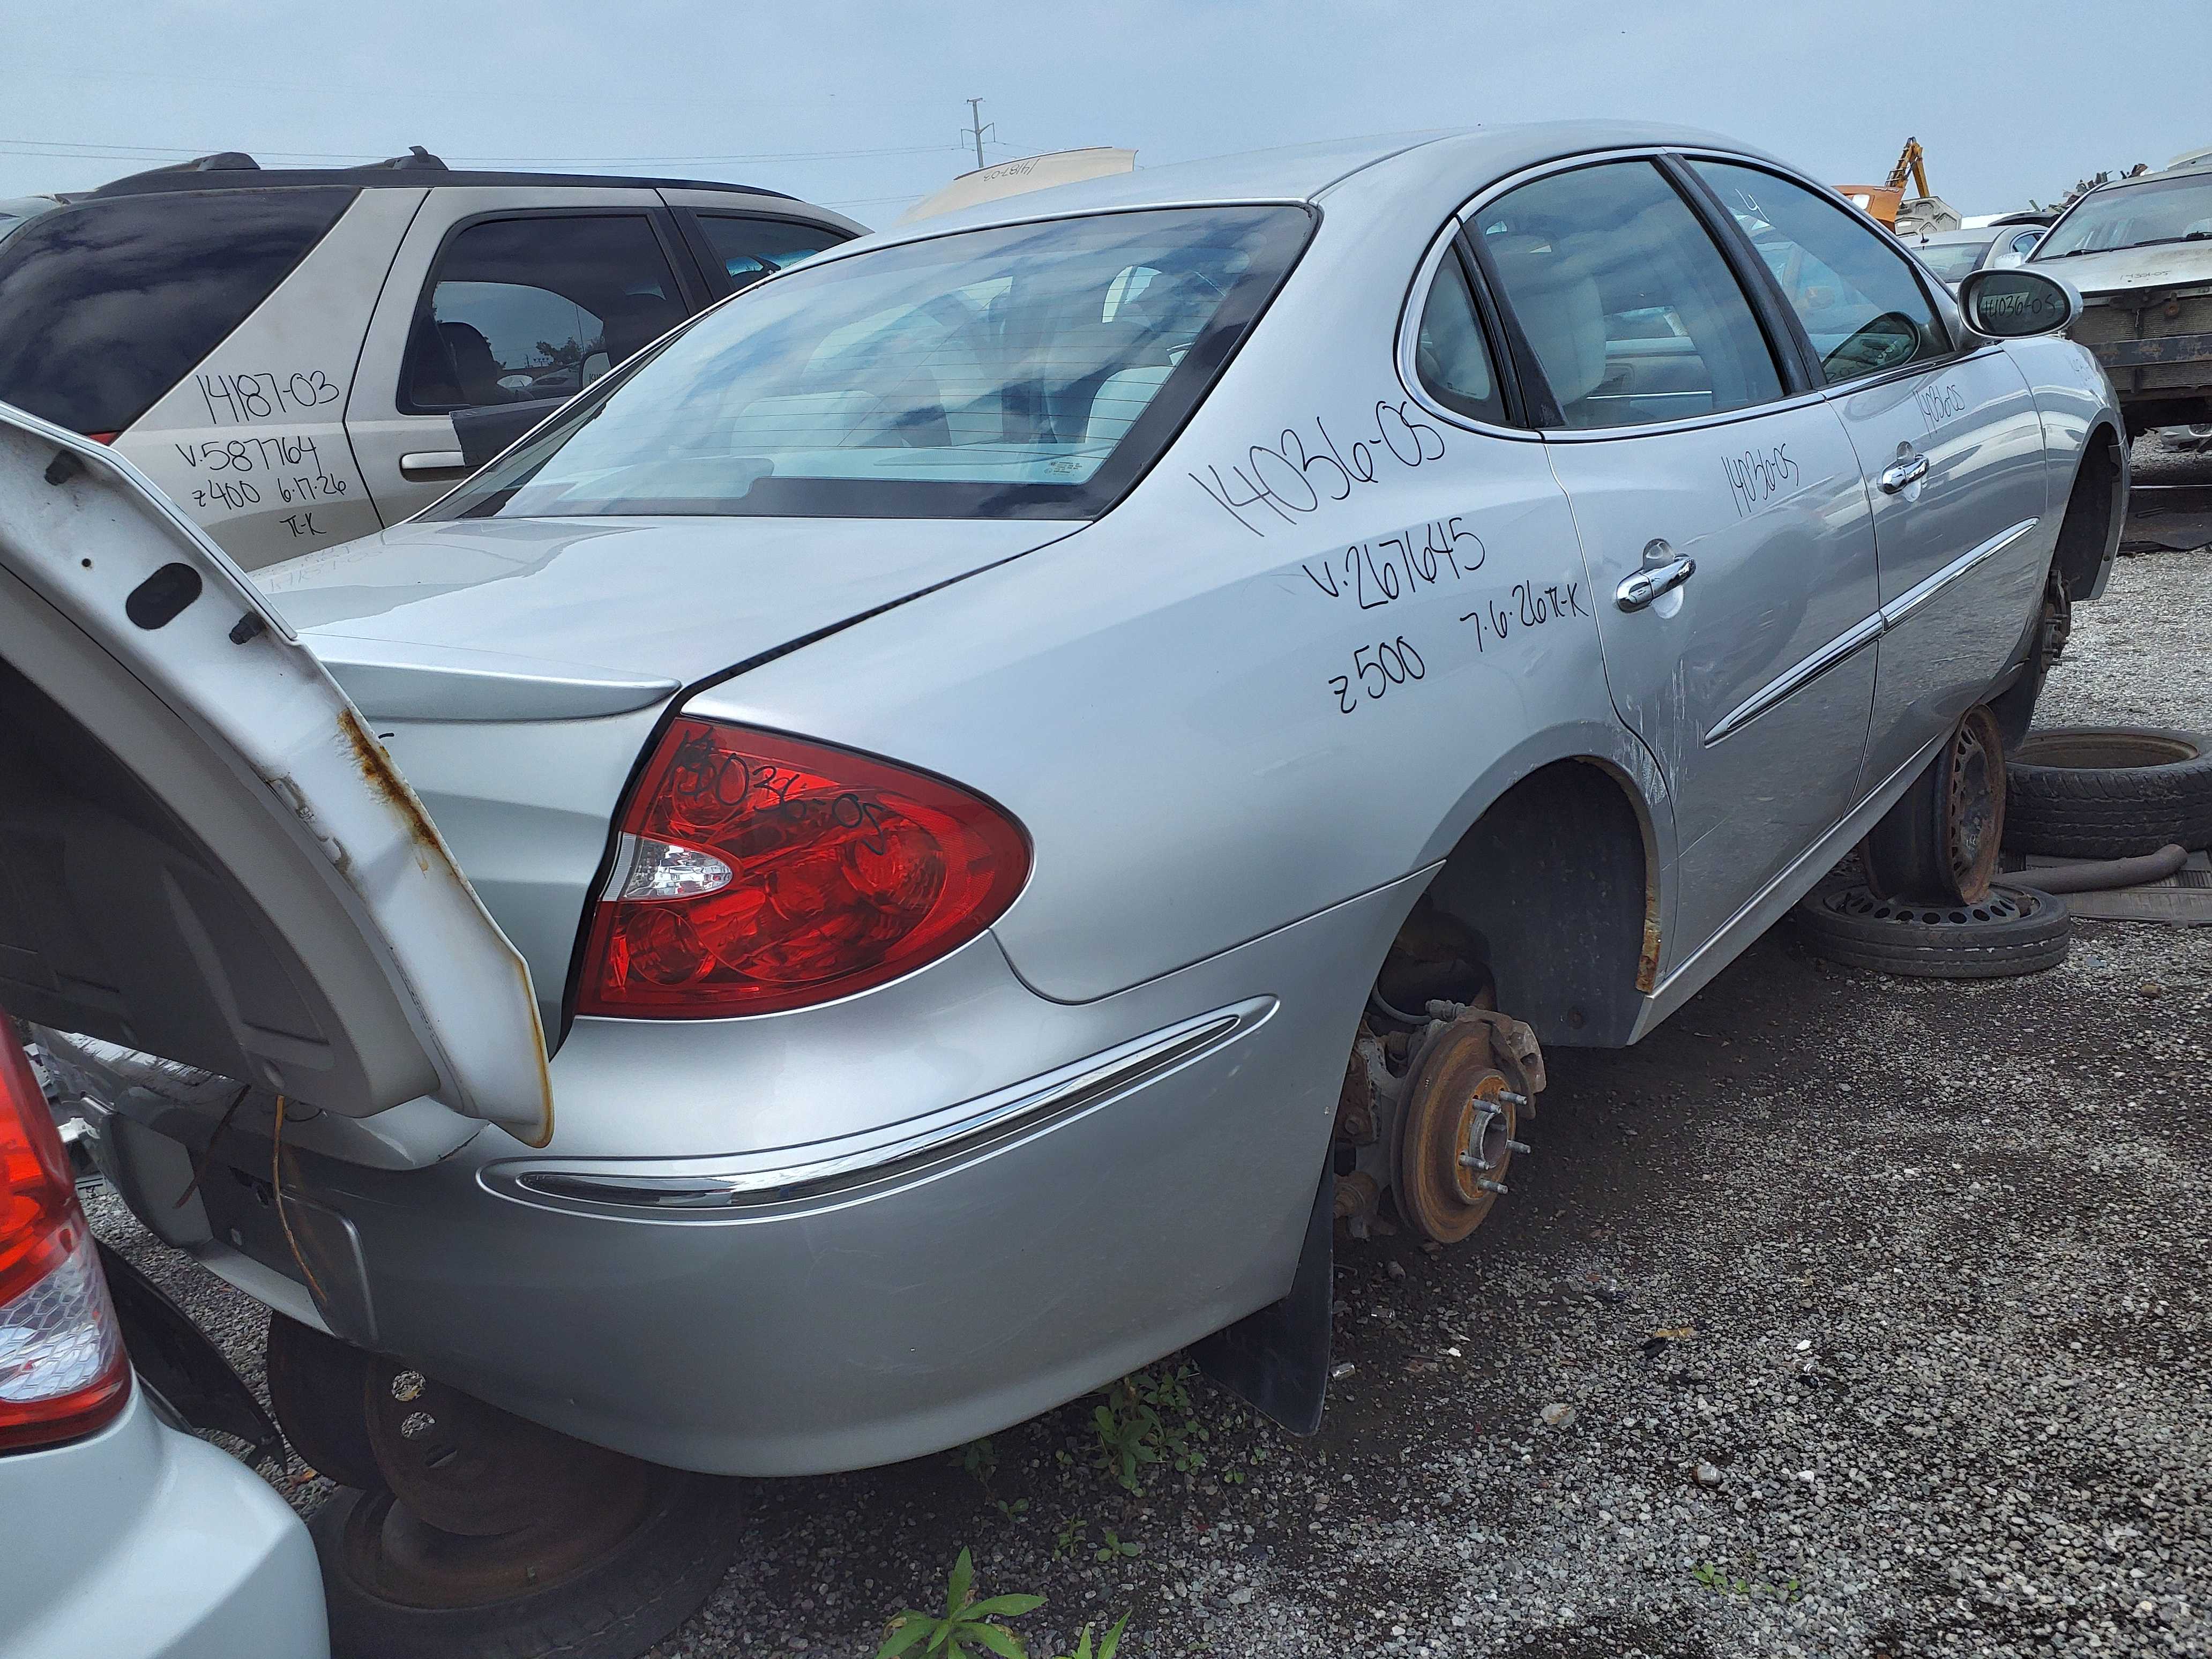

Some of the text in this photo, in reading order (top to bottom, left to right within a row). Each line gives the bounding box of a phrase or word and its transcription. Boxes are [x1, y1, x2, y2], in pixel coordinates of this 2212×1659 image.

[1985, 294, 2056, 319] 14036-05
[196, 370, 339, 424] 14187-03
[1189, 401, 1445, 537] 14036-05
